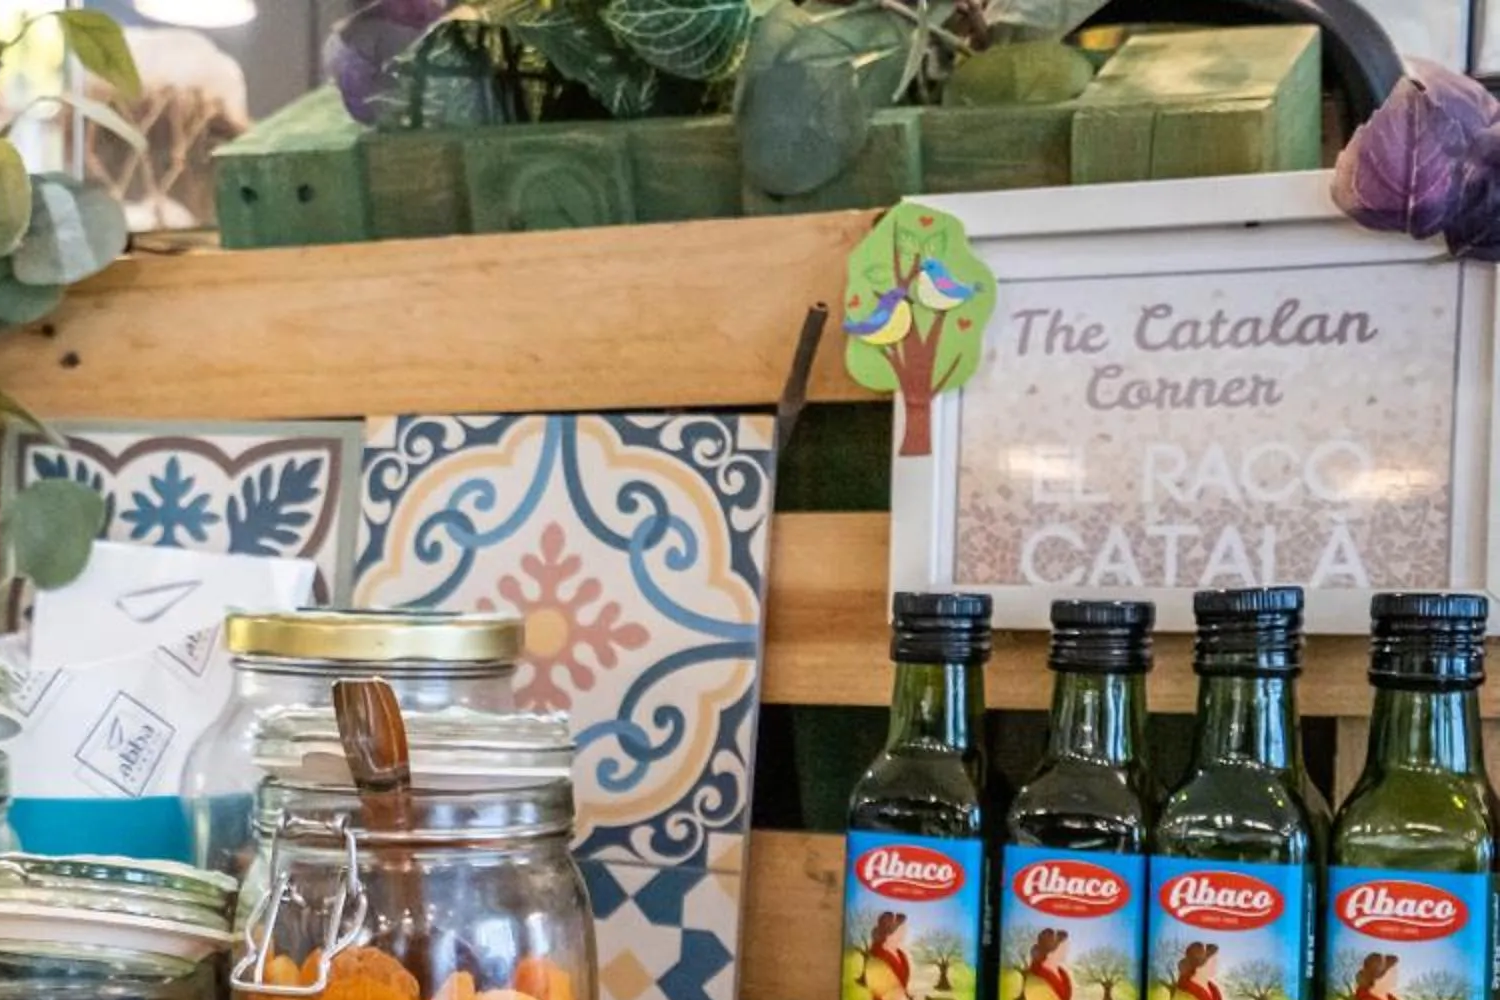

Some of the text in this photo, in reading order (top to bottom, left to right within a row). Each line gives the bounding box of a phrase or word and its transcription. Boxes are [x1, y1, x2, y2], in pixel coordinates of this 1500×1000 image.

[1012, 299, 1378, 356] The Catalan
[1085, 364, 1284, 411] Corner
[1033, 444, 1109, 503] EL
[864, 849, 957, 888] Abaco
[1023, 865, 1121, 904] Abaco
[1169, 876, 1275, 918] Abaco
[1345, 886, 1457, 928] Abaco
